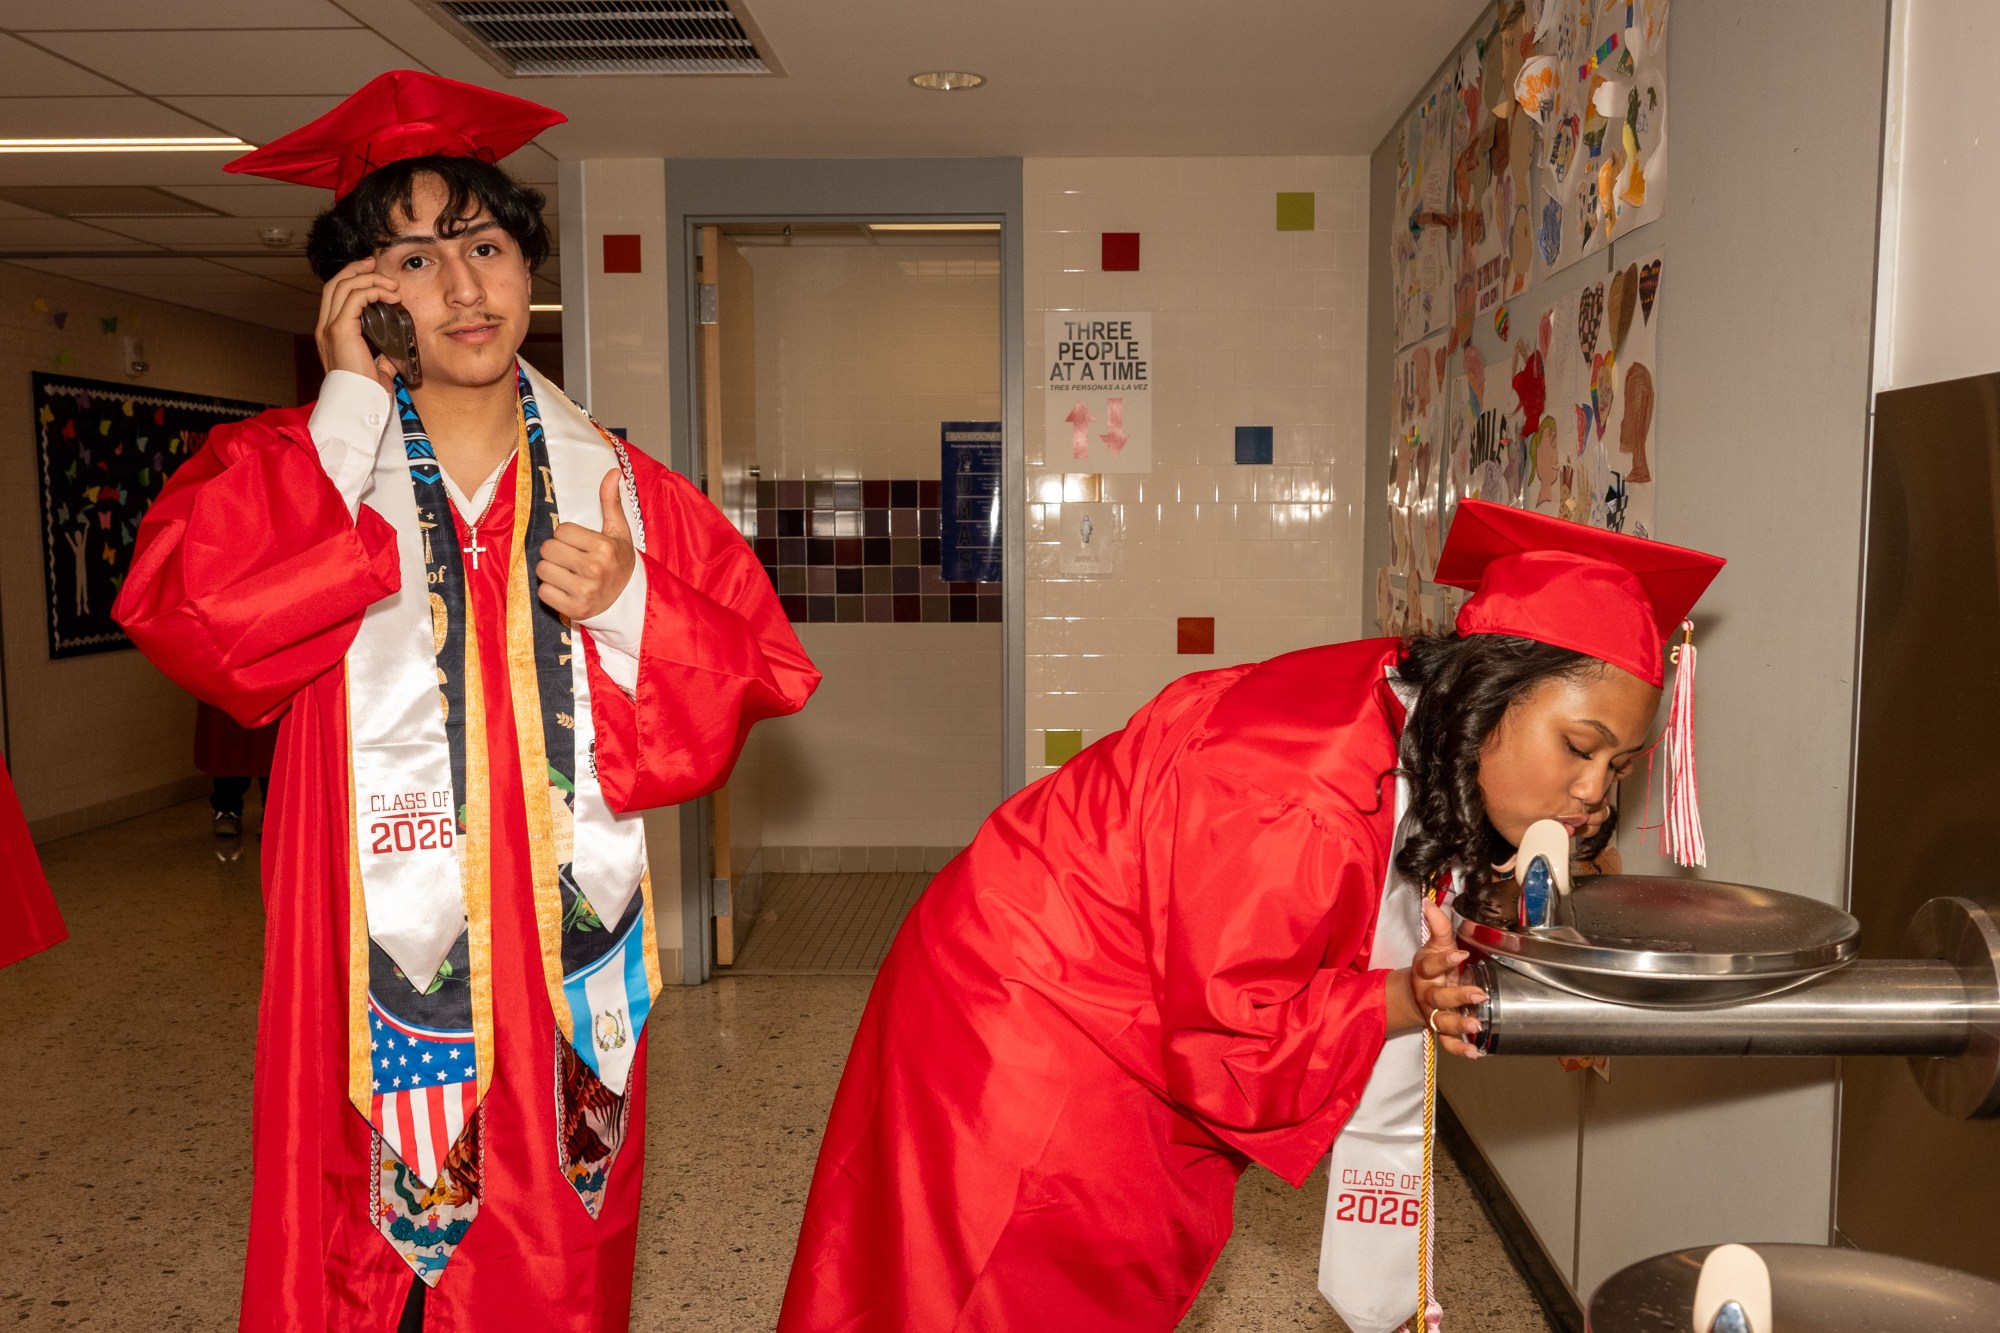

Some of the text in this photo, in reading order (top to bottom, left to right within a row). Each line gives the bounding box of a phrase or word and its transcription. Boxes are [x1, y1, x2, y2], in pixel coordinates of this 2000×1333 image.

[1064, 321, 1132, 340] THREE
[1058, 341, 1139, 361] PEOPLE
[1049, 361, 1147, 381] AT A TIME
[1071, 383, 1114, 391] PERSONAS
[1114, 383, 1121, 391] A
[1121, 383, 1132, 391] LA
[1133, 383, 1149, 391] VEZ
[427, 565, 446, 584] of
[370, 791, 450, 812] CLASS OF
[370, 818, 453, 855] 2026
[1342, 1168, 1422, 1190] CLASS OF
[1336, 1193, 1420, 1227] 2026
